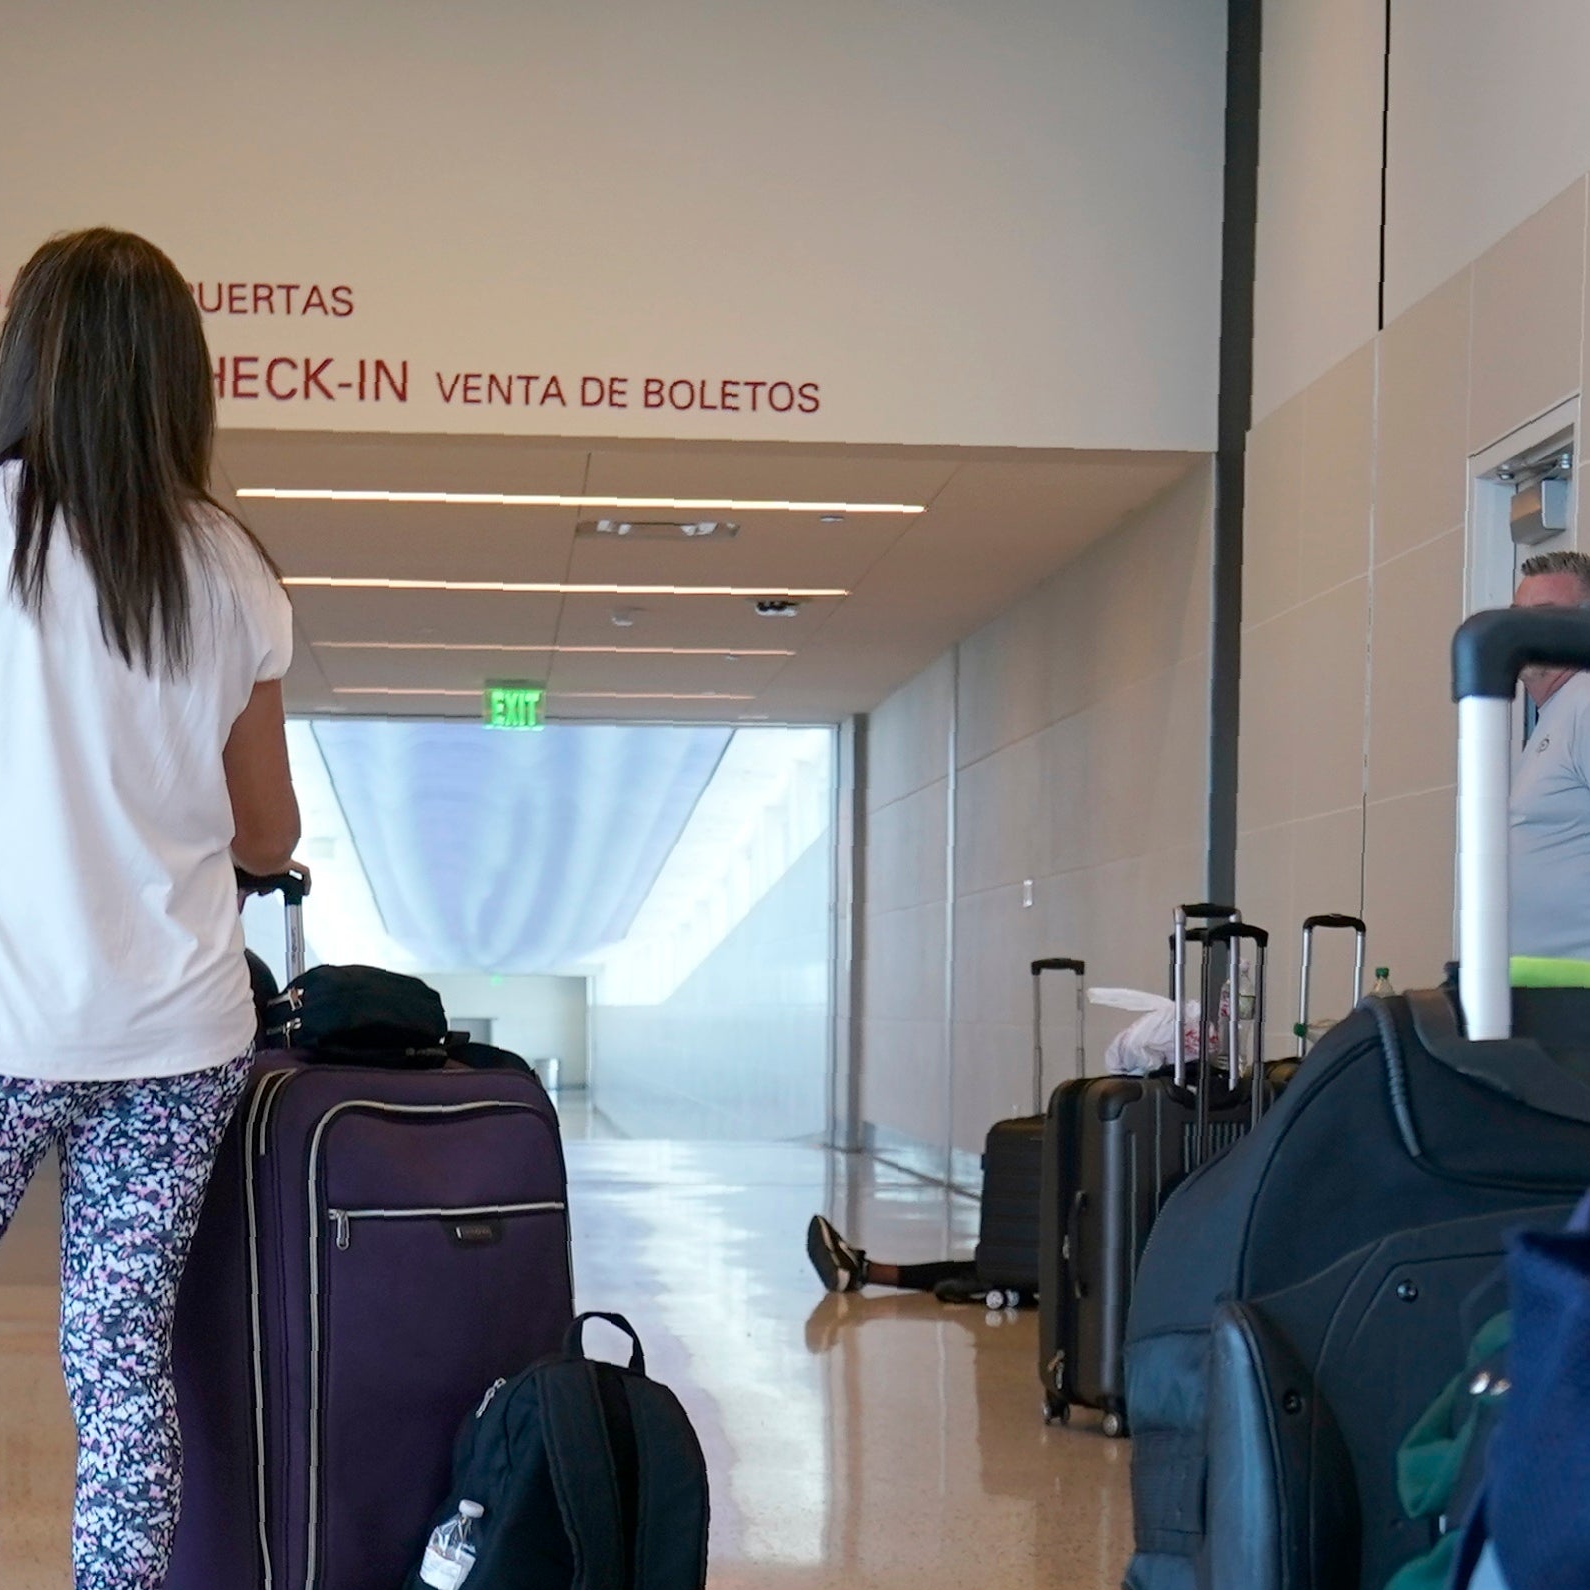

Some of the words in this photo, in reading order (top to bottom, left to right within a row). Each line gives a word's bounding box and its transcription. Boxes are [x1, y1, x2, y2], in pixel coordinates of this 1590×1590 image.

[187, 282, 354, 317] UERTAS
[436, 372, 566, 406] VENTA
[580, 376, 629, 408] DE
[643, 378, 821, 413] BOLETOS
[492, 688, 541, 727] EXIT
